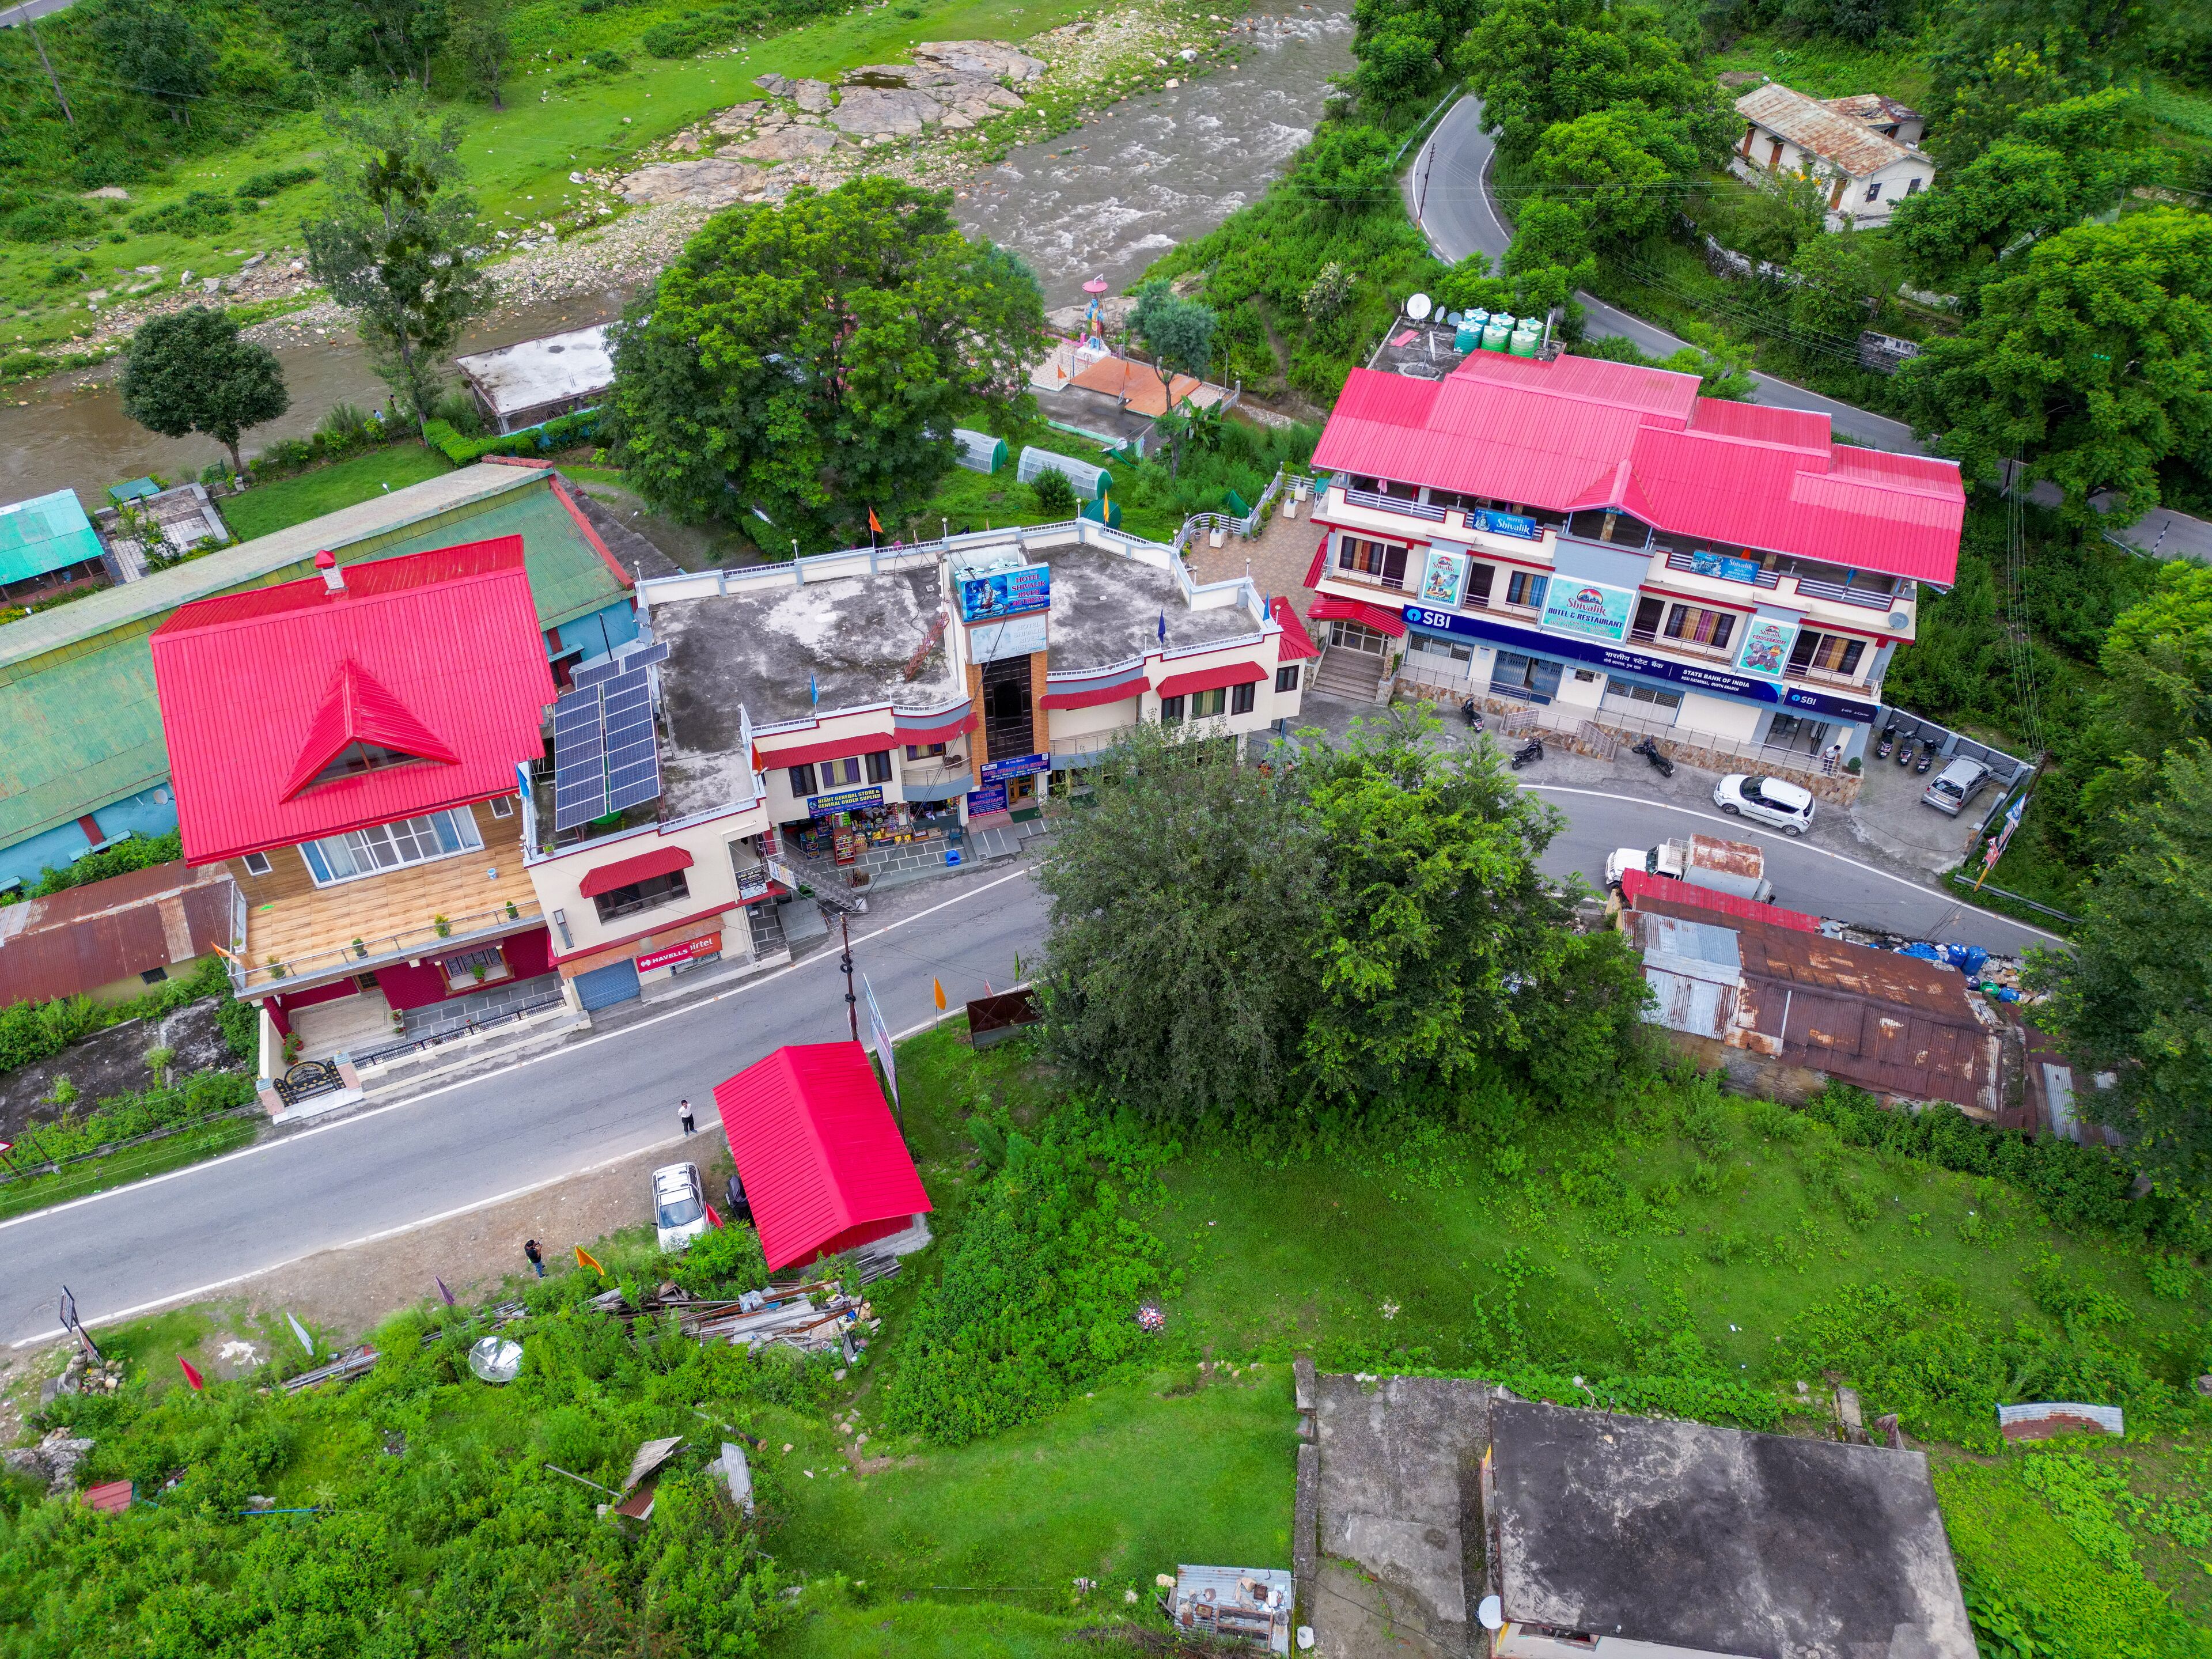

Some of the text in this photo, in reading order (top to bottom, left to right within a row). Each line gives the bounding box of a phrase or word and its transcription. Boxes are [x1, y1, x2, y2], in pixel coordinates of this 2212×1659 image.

[1497, 518, 1531, 535] Shivalik
[1433, 562, 1455, 572] Shivalik
[1728, 559, 1753, 570] Shivalik
[1016, 574, 1041, 583] HOTEL
[1012, 581, 1046, 591] SHIVALIK
[1018, 589, 1040, 598] RIVER
[1012, 596, 1046, 606] RETREAT
[1566, 597, 1607, 616] Shivalik
[1423, 611, 1450, 628] SBI
[1548, 607, 1568, 618] HOTEL
[1577, 613, 1623, 628] RESTAURANT
[1760, 630, 1781, 639] Shivalik
[1605, 652, 1664, 669] भारतीय स्टेट बैंक
[1683, 669, 1702, 678] STATE
[1703, 674, 1721, 682] BANK
[1732, 680, 1749, 688] INDIA
[1800, 696, 1816, 705] SBI
[969, 796, 1005, 806] RESTAURANT
[652, 949, 688, 963] HAVELLS
